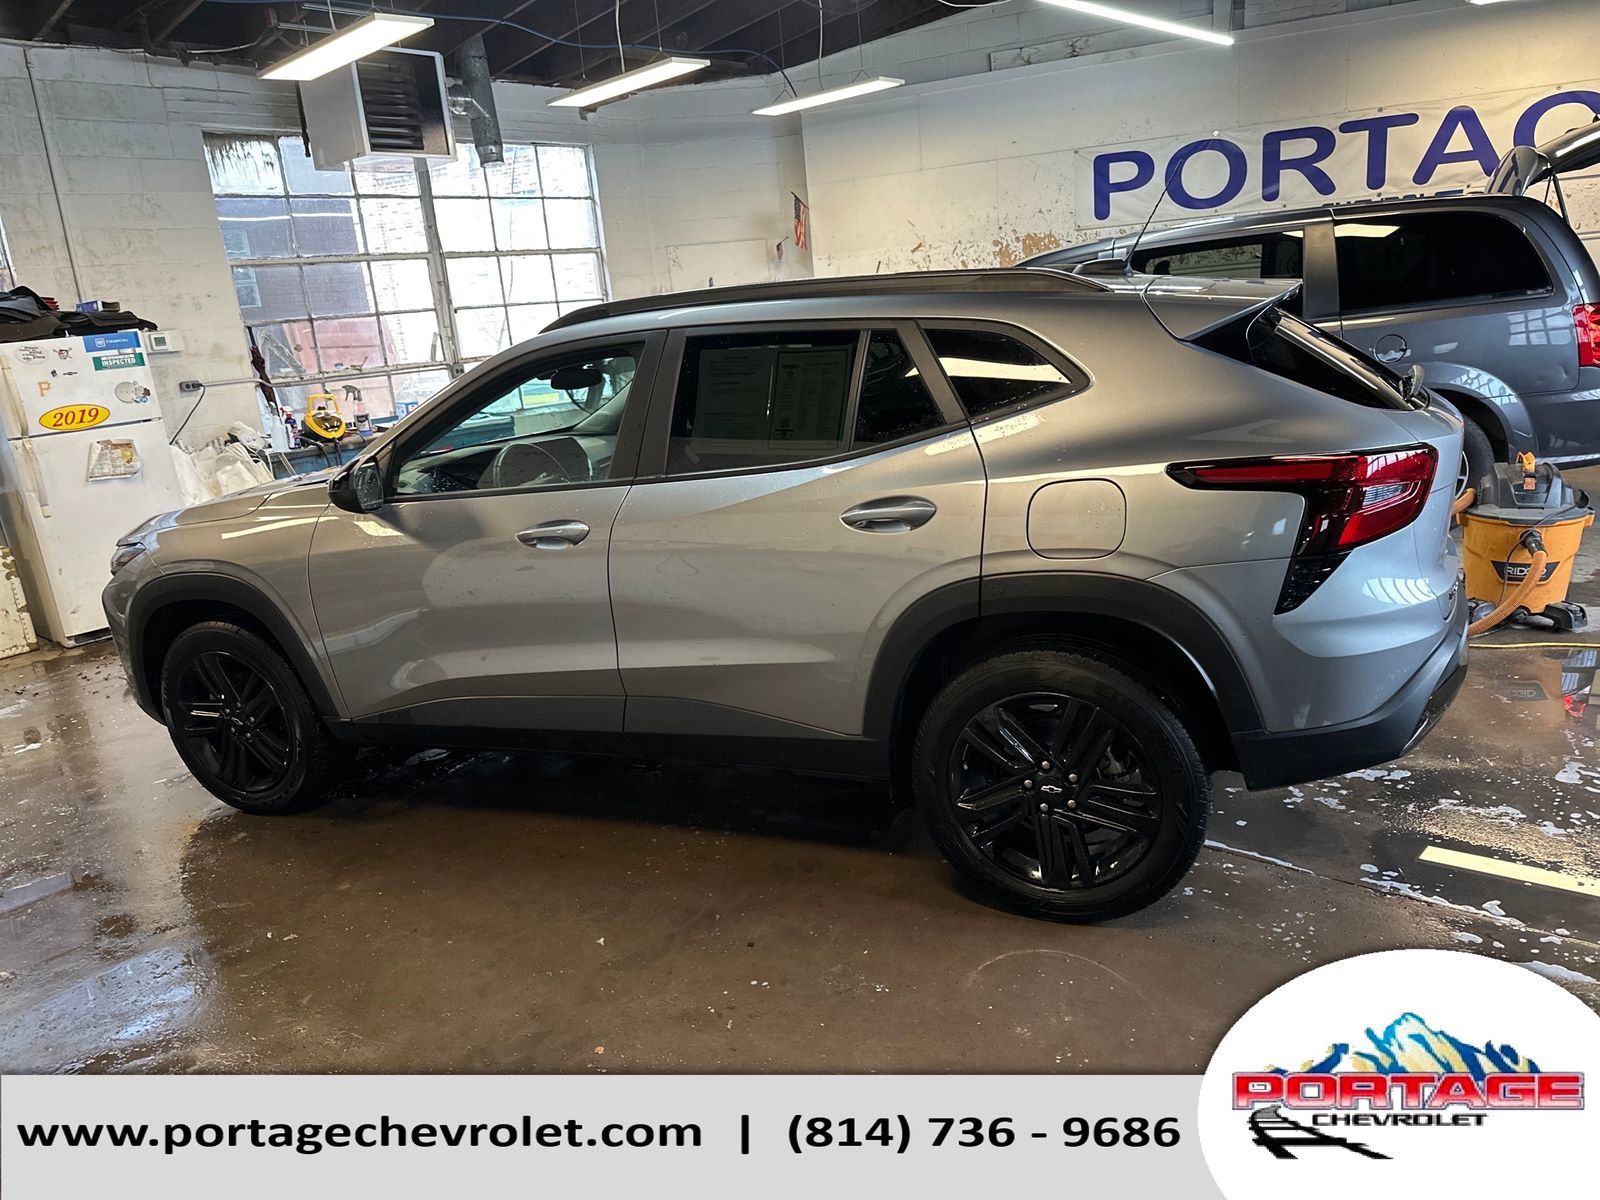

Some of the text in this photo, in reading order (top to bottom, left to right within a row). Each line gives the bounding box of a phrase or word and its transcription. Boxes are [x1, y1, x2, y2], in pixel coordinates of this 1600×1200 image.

[101, 357, 136, 367] INSPECTED
[52, 407, 100, 428] 2019
[1505, 565, 1547, 576] RID
